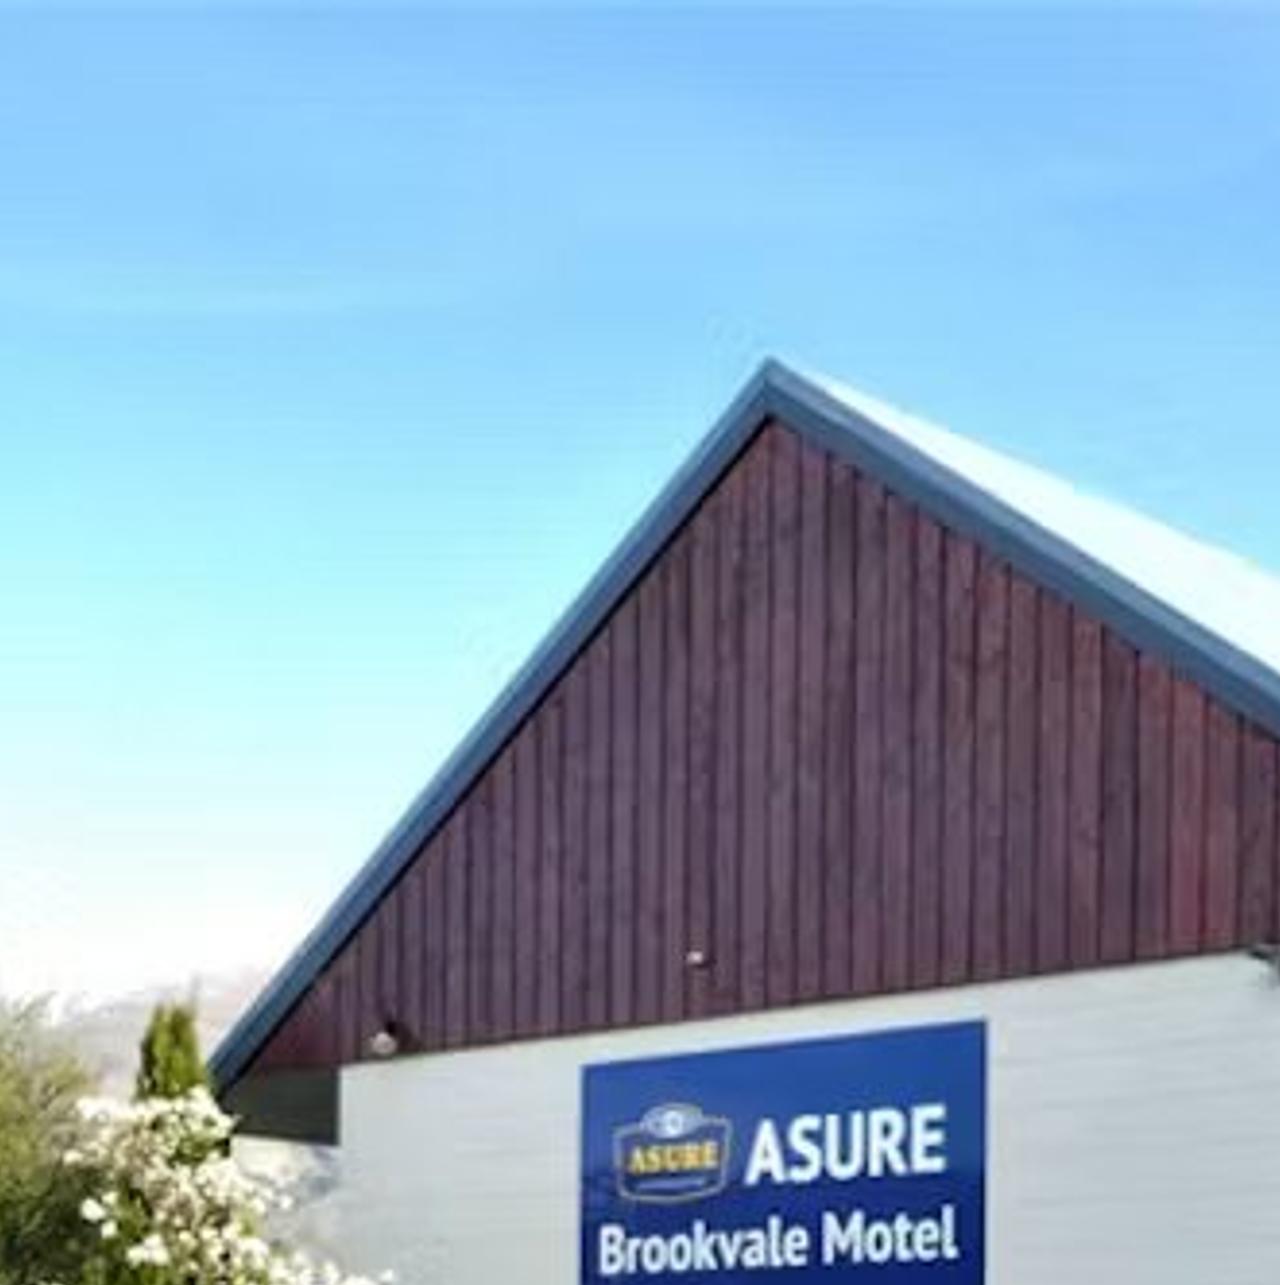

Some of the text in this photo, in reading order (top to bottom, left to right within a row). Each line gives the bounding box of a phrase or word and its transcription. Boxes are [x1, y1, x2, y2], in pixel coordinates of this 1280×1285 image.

[629, 1141, 719, 1174] ASURE
[745, 1104, 947, 1186] ASURE
[598, 1205, 959, 1277] Brookvale Motel
